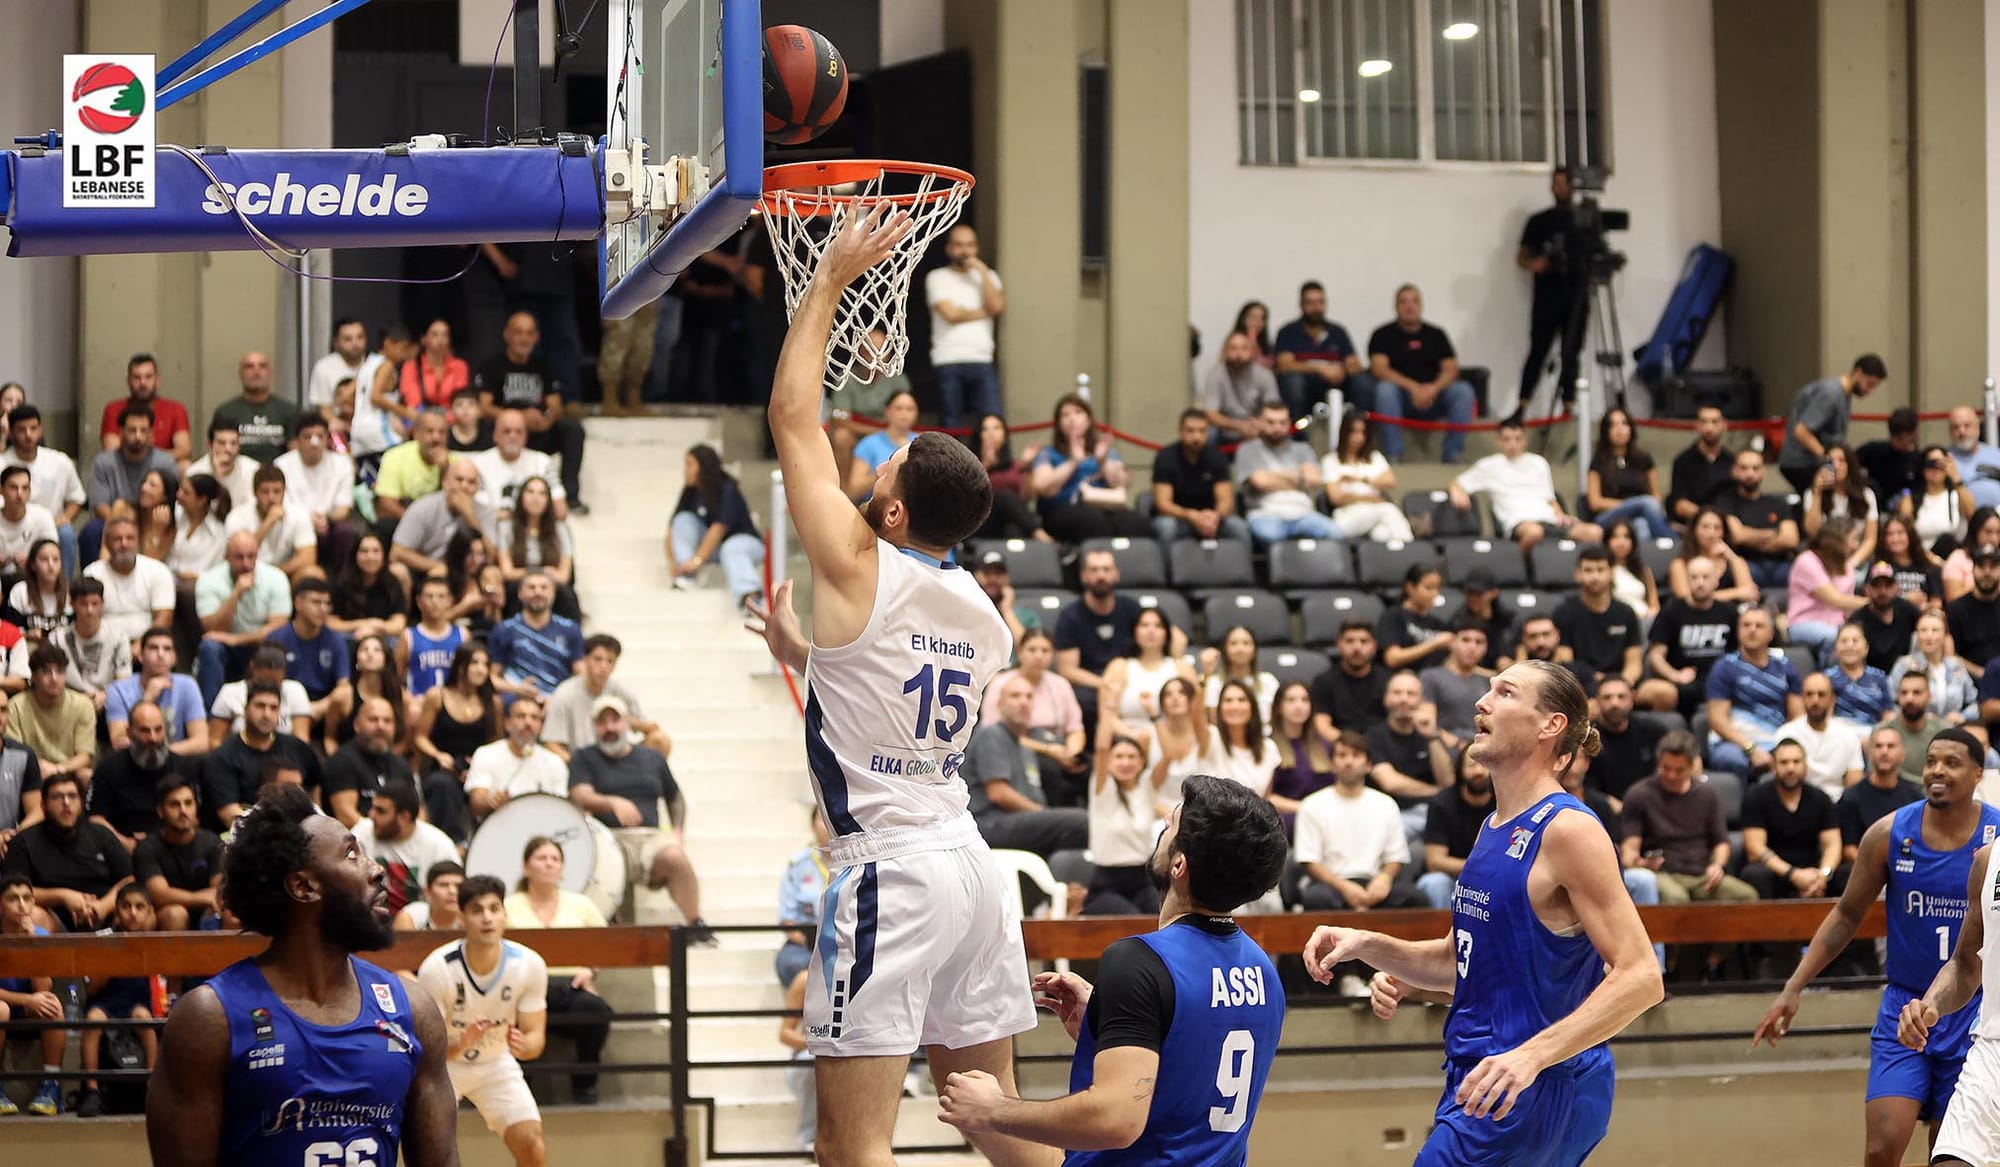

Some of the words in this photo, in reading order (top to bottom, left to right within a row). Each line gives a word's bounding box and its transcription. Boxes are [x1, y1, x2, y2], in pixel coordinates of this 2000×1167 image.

[201, 172, 429, 217] schelde
[911, 633, 927, 651] El
[929, 636, 975, 660] khatib
[1680, 624, 1731, 649] UFC
[903, 663, 971, 743] 15
[870, 754, 902, 775] ELKA
[1935, 925, 1950, 961] 1
[1210, 965, 1266, 1008] ASSI
[249, 1043, 285, 1058] capelli
[1208, 1029, 1255, 1133] 9
